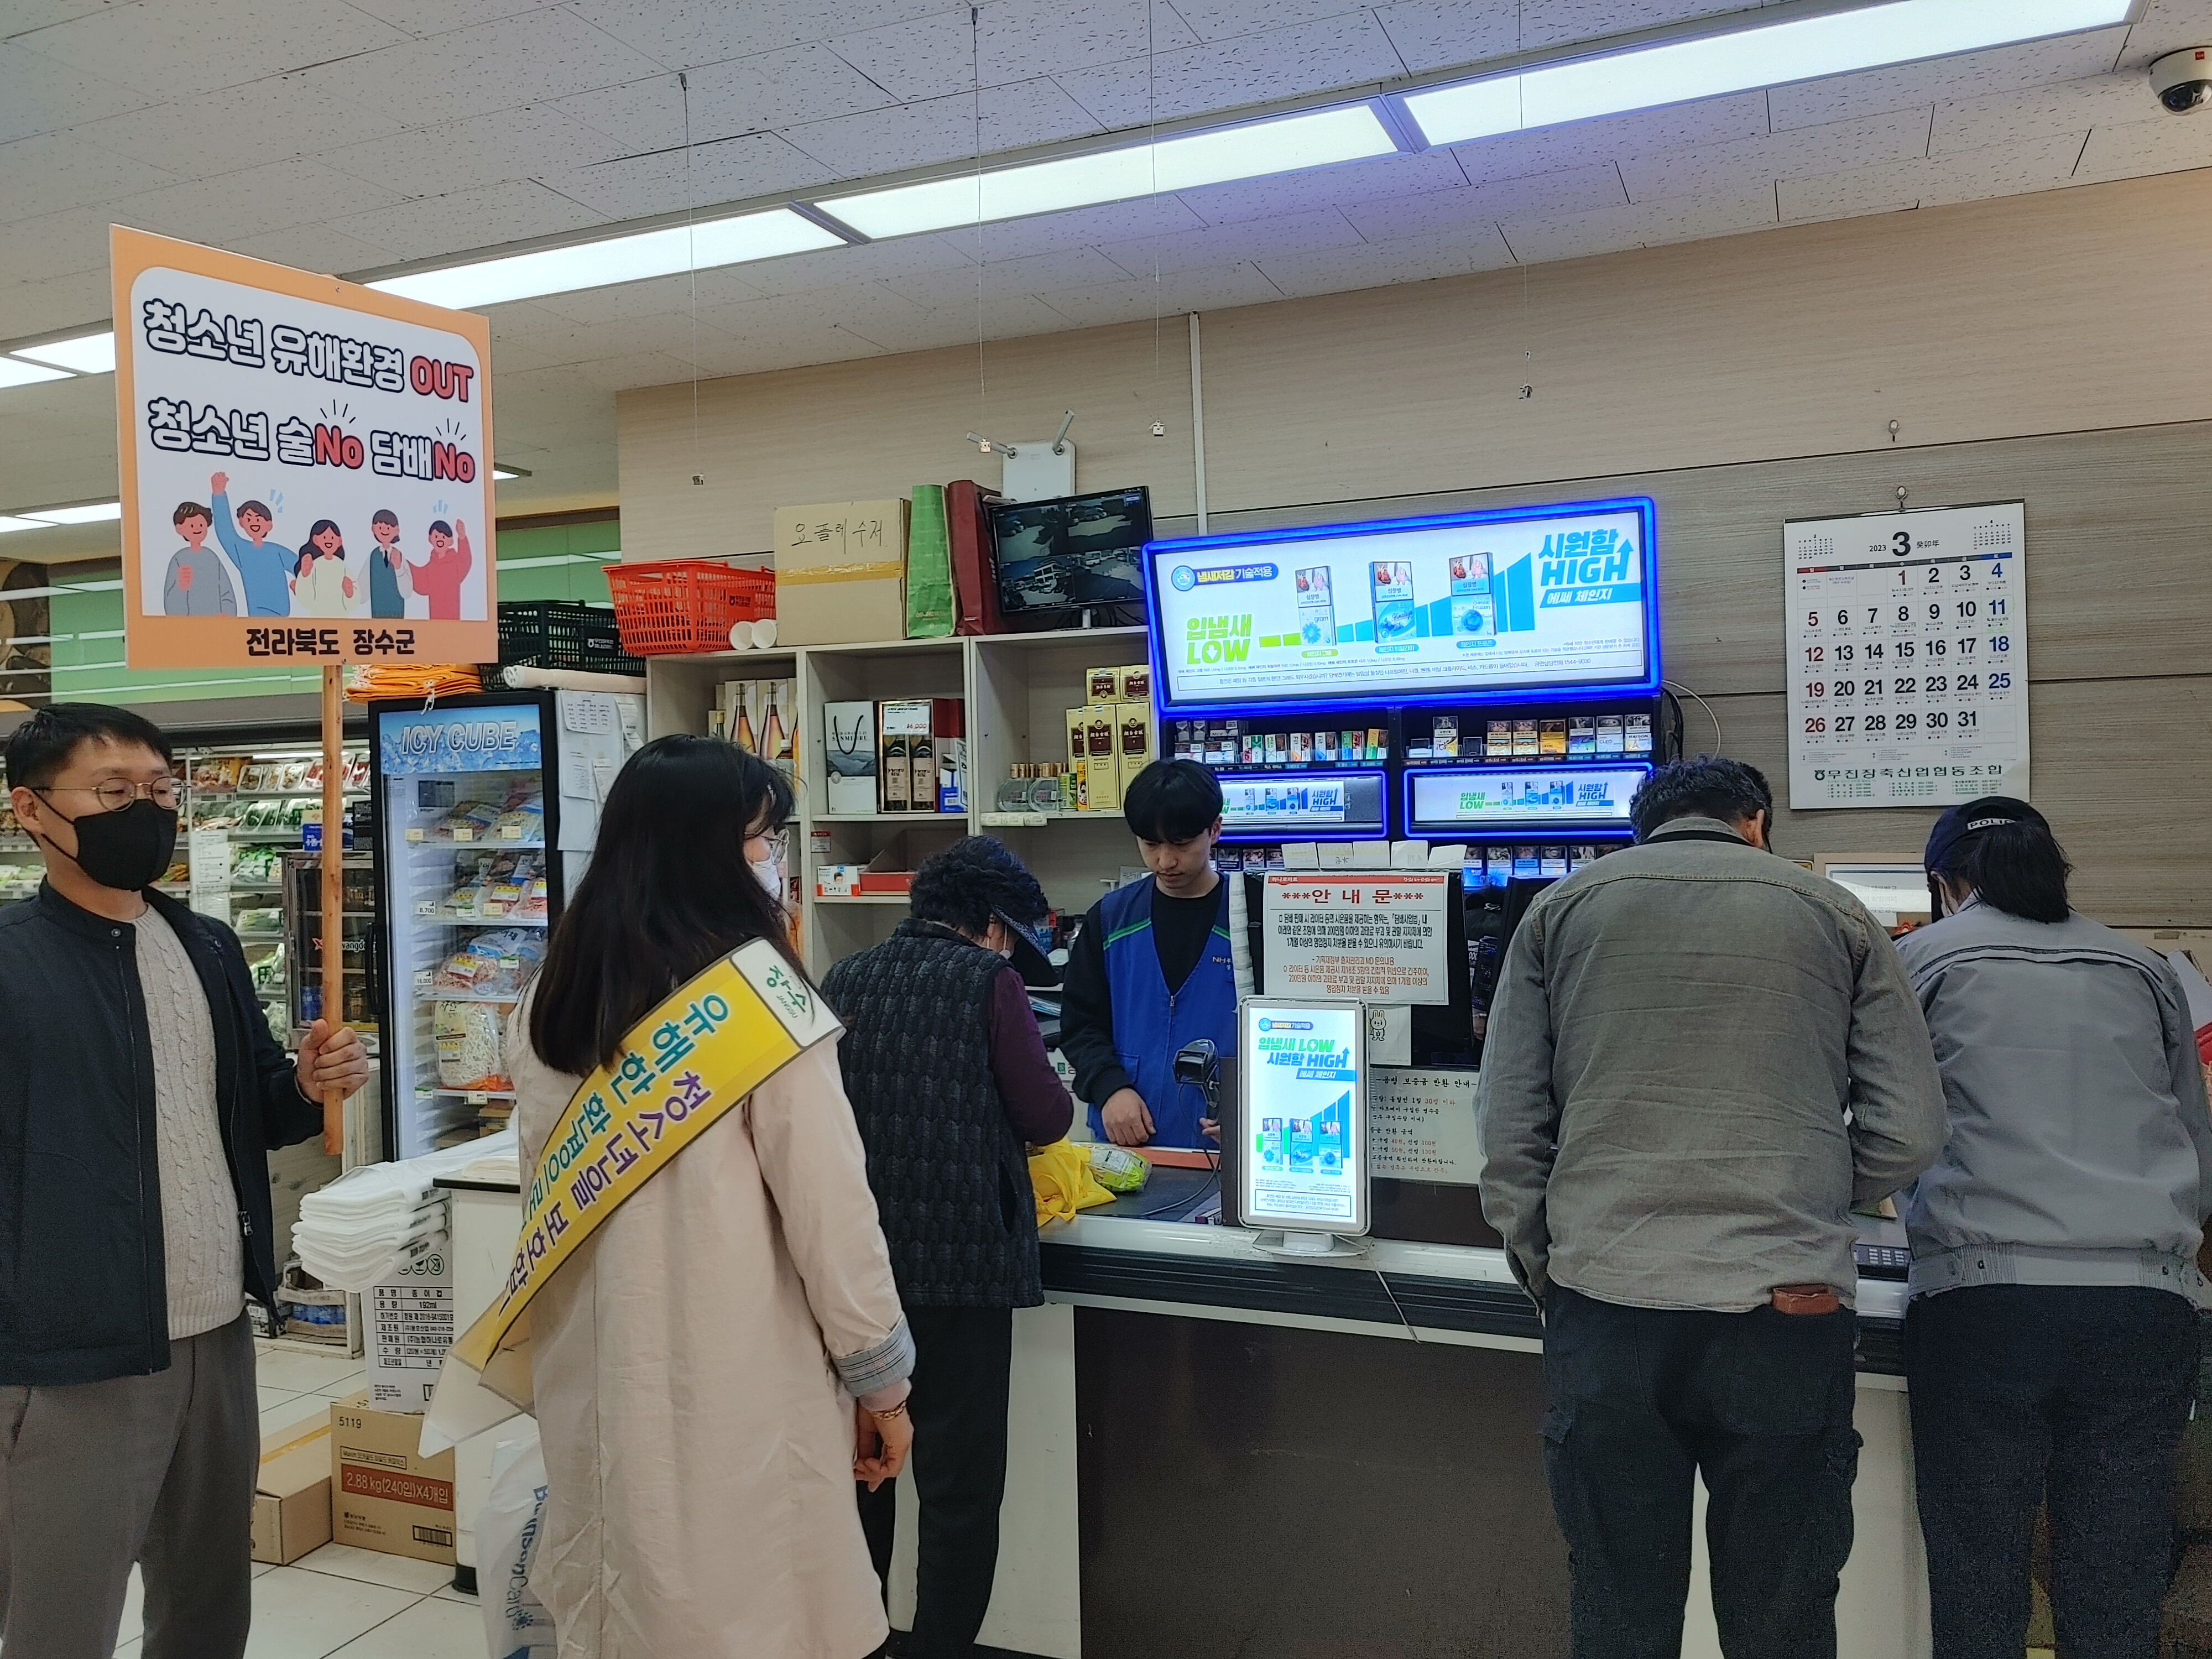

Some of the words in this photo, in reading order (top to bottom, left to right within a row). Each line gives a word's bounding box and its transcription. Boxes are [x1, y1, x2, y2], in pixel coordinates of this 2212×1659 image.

[143, 298, 265, 369] 청소년
[271, 325, 404, 393] 유해환경
[410, 356, 474, 403] OUT
[148, 397, 270, 461] 청소년
[1539, 528, 1619, 559] 시원함
[1869, 544, 1887, 552] 2023
[1892, 532, 1911, 556] 3
[1235, 566, 1272, 579] 기술적용
[1541, 551, 1629, 586] HIGH
[1898, 571, 1906, 585] 1
[1928, 568, 1939, 583] 2
[1959, 565, 1971, 581] 3
[1991, 562, 2003, 578] 4
[1575, 588, 1612, 602] 체인지
[1808, 612, 1818, 626] 5
[1838, 610, 1848, 625] 6
[1868, 608, 1878, 623] 7
[1898, 606, 1909, 622] 8
[1929, 604, 1940, 619] 9
[1957, 602, 1976, 617] 10
[1989, 599, 2006, 614] 11
[1187, 614, 1252, 640] 입냄새
[247, 629, 340, 656] 전라북도
[353, 630, 415, 655] 장수군
[1187, 639, 1250, 665] LOW
[1805, 646, 1824, 662] 12
[1835, 645, 1854, 660] 13
[1864, 644, 1884, 659] 14
[1895, 641, 1914, 658] 15
[1926, 640, 1945, 656] 16
[1958, 638, 1977, 654] 17
[1989, 636, 2010, 652] 18
[1806, 682, 1824, 698] 19
[1834, 680, 1855, 696] 20
[1864, 679, 1883, 695] 21
[1894, 677, 1916, 694] 22
[1926, 676, 1947, 692] 23
[1957, 674, 1979, 690] 24
[1988, 672, 2011, 689] 25
[1805, 718, 1825, 733] 26
[1834, 716, 1855, 732] 27
[1864, 715, 1886, 731] 28
[1895, 713, 1917, 730] 29
[1926, 712, 1948, 729] 30
[1958, 711, 1977, 727] 31
[401, 723, 443, 755] ICY
[447, 721, 518, 753] CUBE
[1459, 801, 1485, 810] LOW
[1285, 914, 1293, 923] 담배
[1295, 914, 1303, 923] 판매
[1311, 914, 1323, 923] 라이터
[1327, 926, 1344, 936] 200만원
[775, 995, 799, 1018] JANGSU
[608, 994, 729, 1105] 유해한
[1258, 1037, 1296, 1051] 입냄새
[1298, 1039, 1335, 1052] LOW
[1267, 1052, 1305, 1066] 시원함
[1306, 1051, 1349, 1068] HIGH
[1403, 1077, 1428, 1086] 보증금
[1433, 1078, 1449, 1087] 반환
[571, 1071, 712, 1211] 청소년을
[339, 1416, 362, 1428] 5119
[347, 1472, 368, 1488] 2.88
